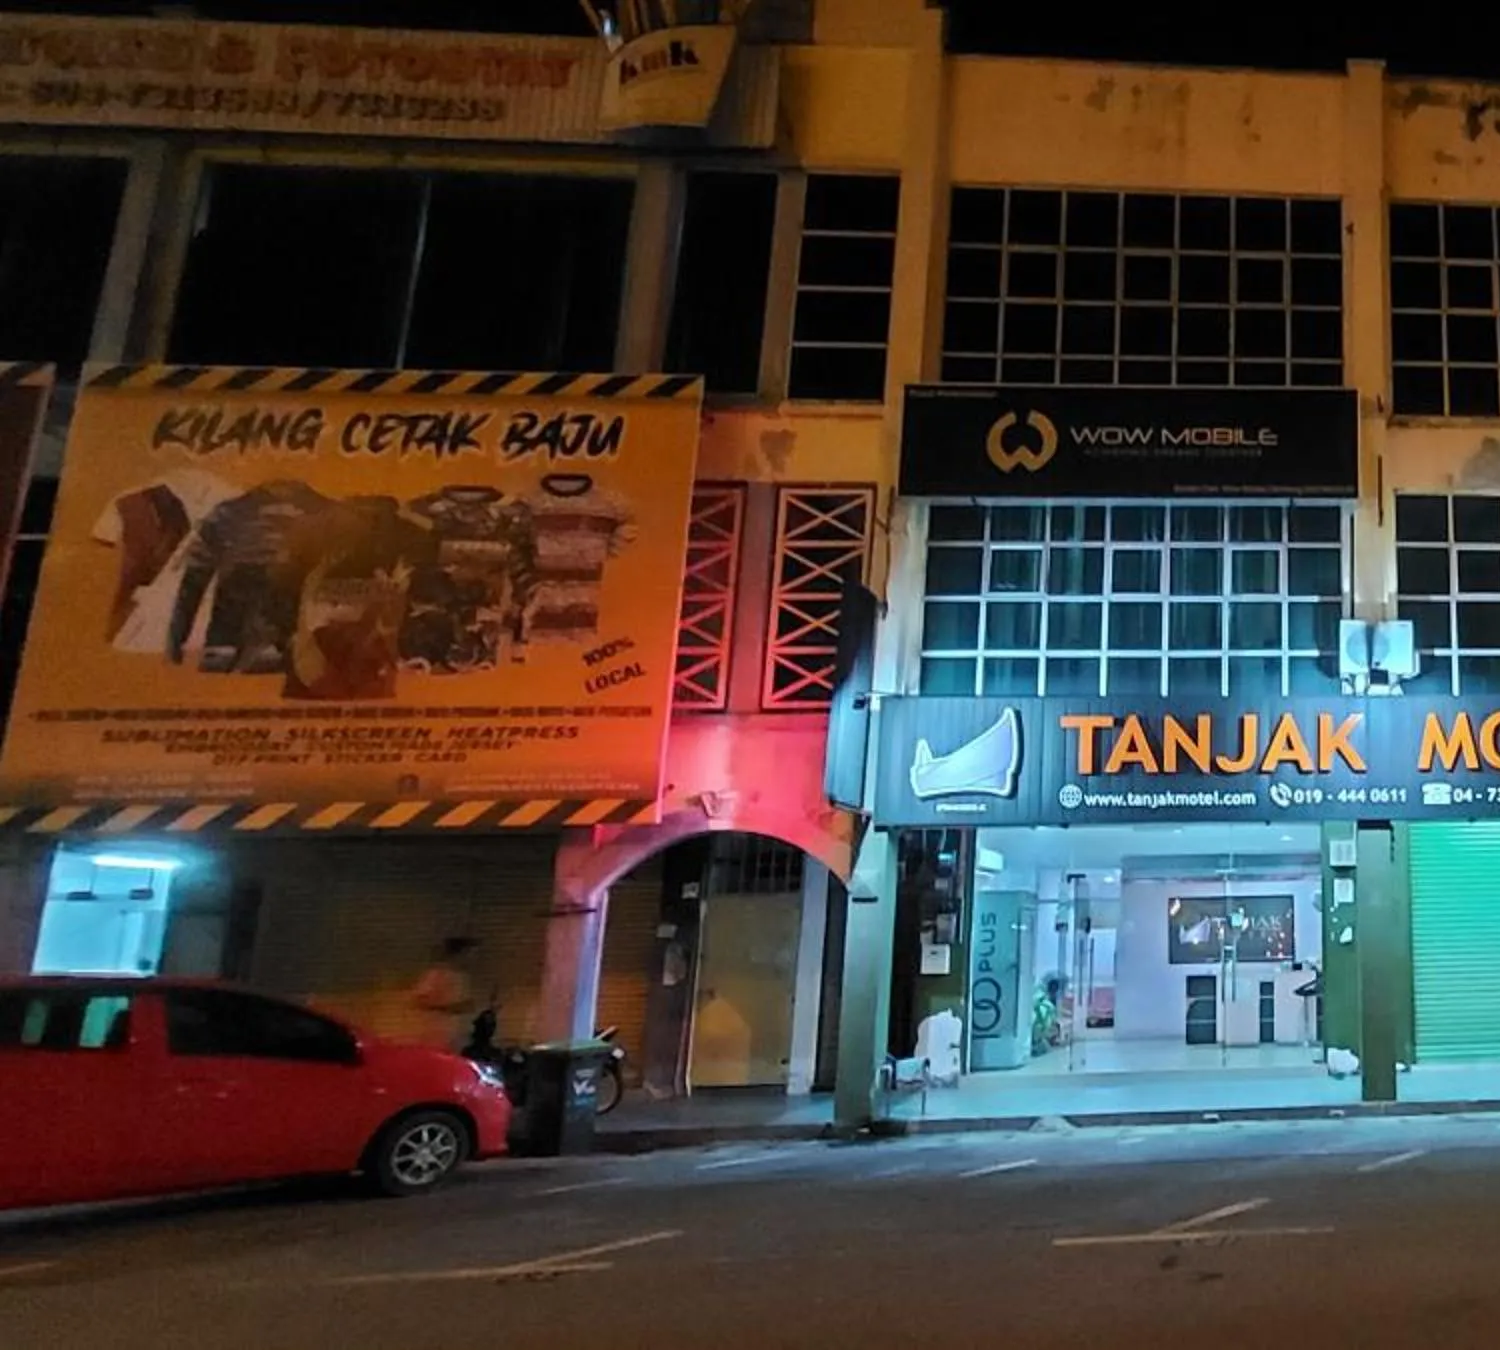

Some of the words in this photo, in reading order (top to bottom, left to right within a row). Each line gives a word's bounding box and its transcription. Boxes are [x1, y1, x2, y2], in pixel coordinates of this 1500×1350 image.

[152, 407, 325, 455] KILANG
[341, 410, 494, 457] CETAK
[501, 412, 626, 460] BAJU
[1069, 426, 1154, 446] WOW
[1160, 427, 1279, 447] MOBILE
[584, 661, 648, 694] LOCAL
[101, 727, 270, 743] SUBLIMATION
[285, 726, 433, 741] SILKSCREEN
[447, 725, 580, 740] HEATPRESS
[1060, 712, 1366, 776] TANJAK
[1083, 790, 1257, 809] www.tanjakmotel.com
[1293, 788, 1323, 804] 019
[1338, 788, 1366, 803] 444
[1369, 788, 1407, 803] 0611
[1453, 787, 1473, 803] 04
[978, 911, 997, 973] PLUS
